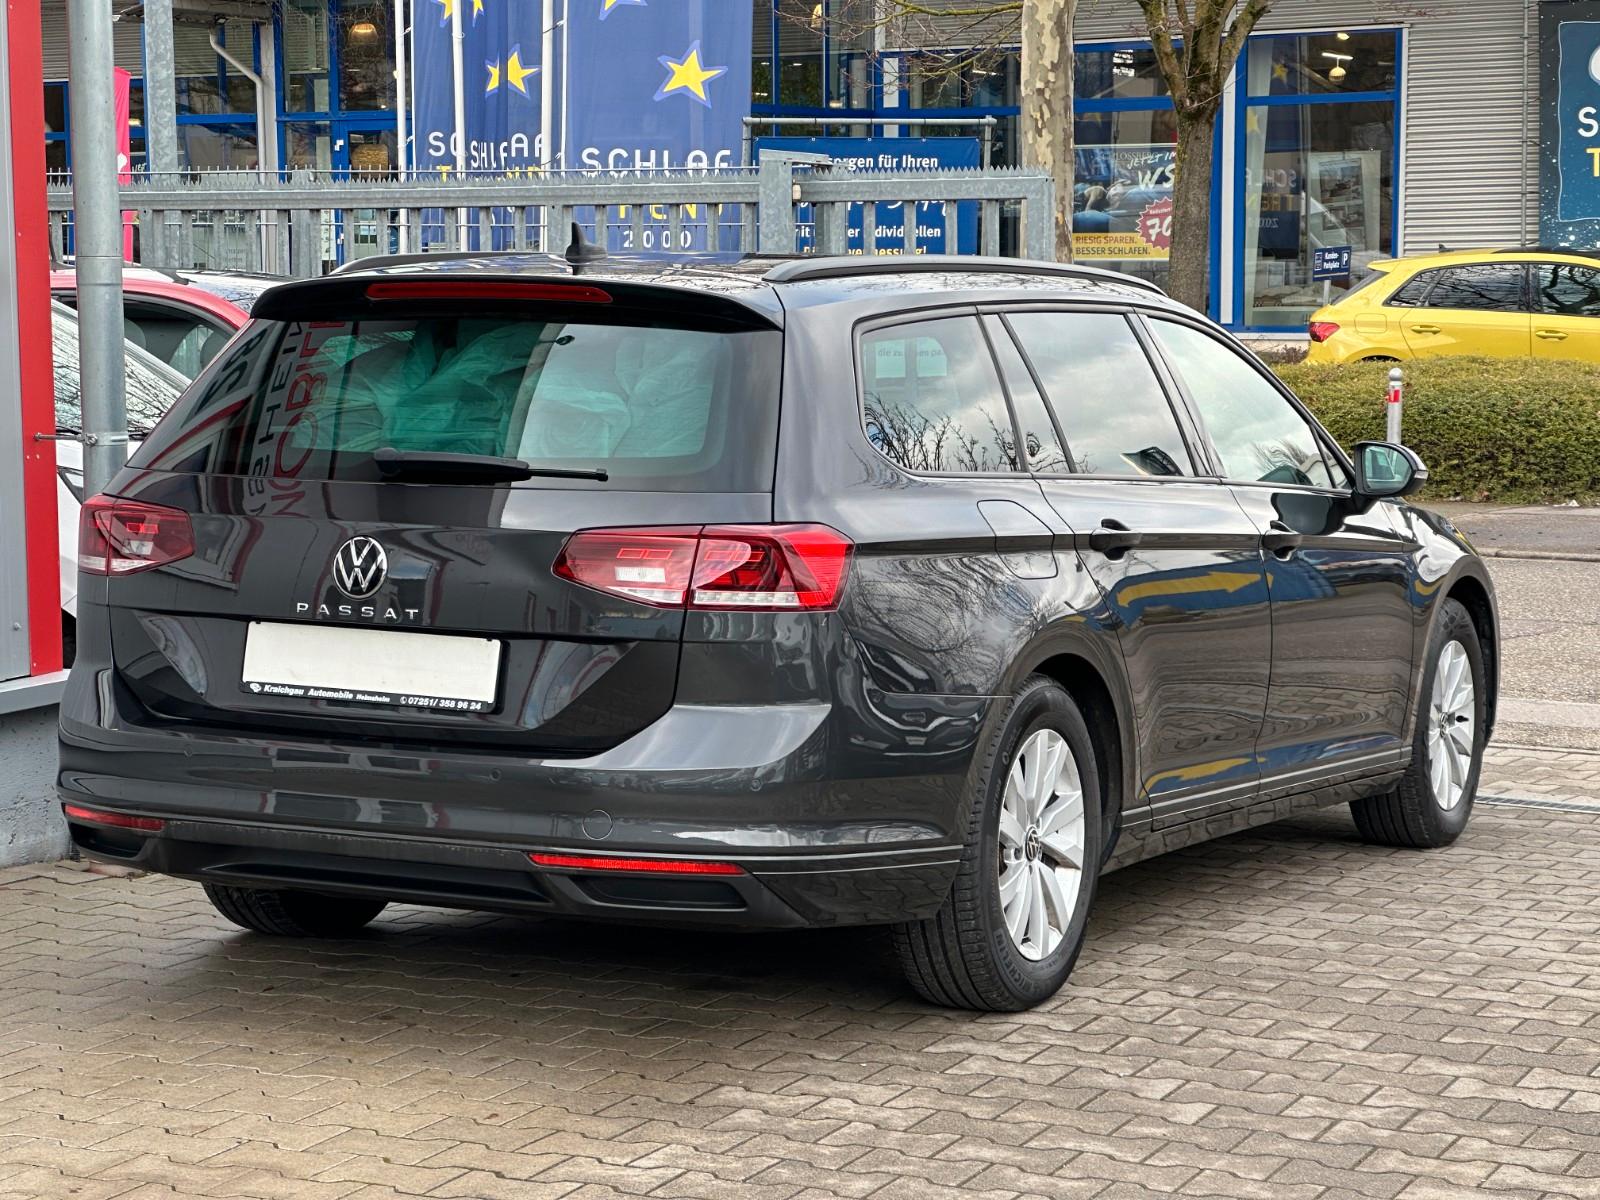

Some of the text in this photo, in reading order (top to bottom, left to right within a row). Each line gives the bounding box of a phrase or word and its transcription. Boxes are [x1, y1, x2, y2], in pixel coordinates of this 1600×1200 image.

[581, 147, 731, 179] SCHLAF
[878, 154, 898, 168] für
[902, 154, 938, 168] Ihren
[623, 230, 692, 249] 2000
[1075, 235, 1137, 245] RIESIG SPAREN.
[1075, 246, 1151, 255] BESSER SCHLAFEN.
[296, 602, 419, 620] PASSAT
[263, 684, 305, 696] Kraichgau
[308, 688, 354, 699] Automobile
[439, 699, 455, 708] 358
[469, 702, 482, 710] 24
